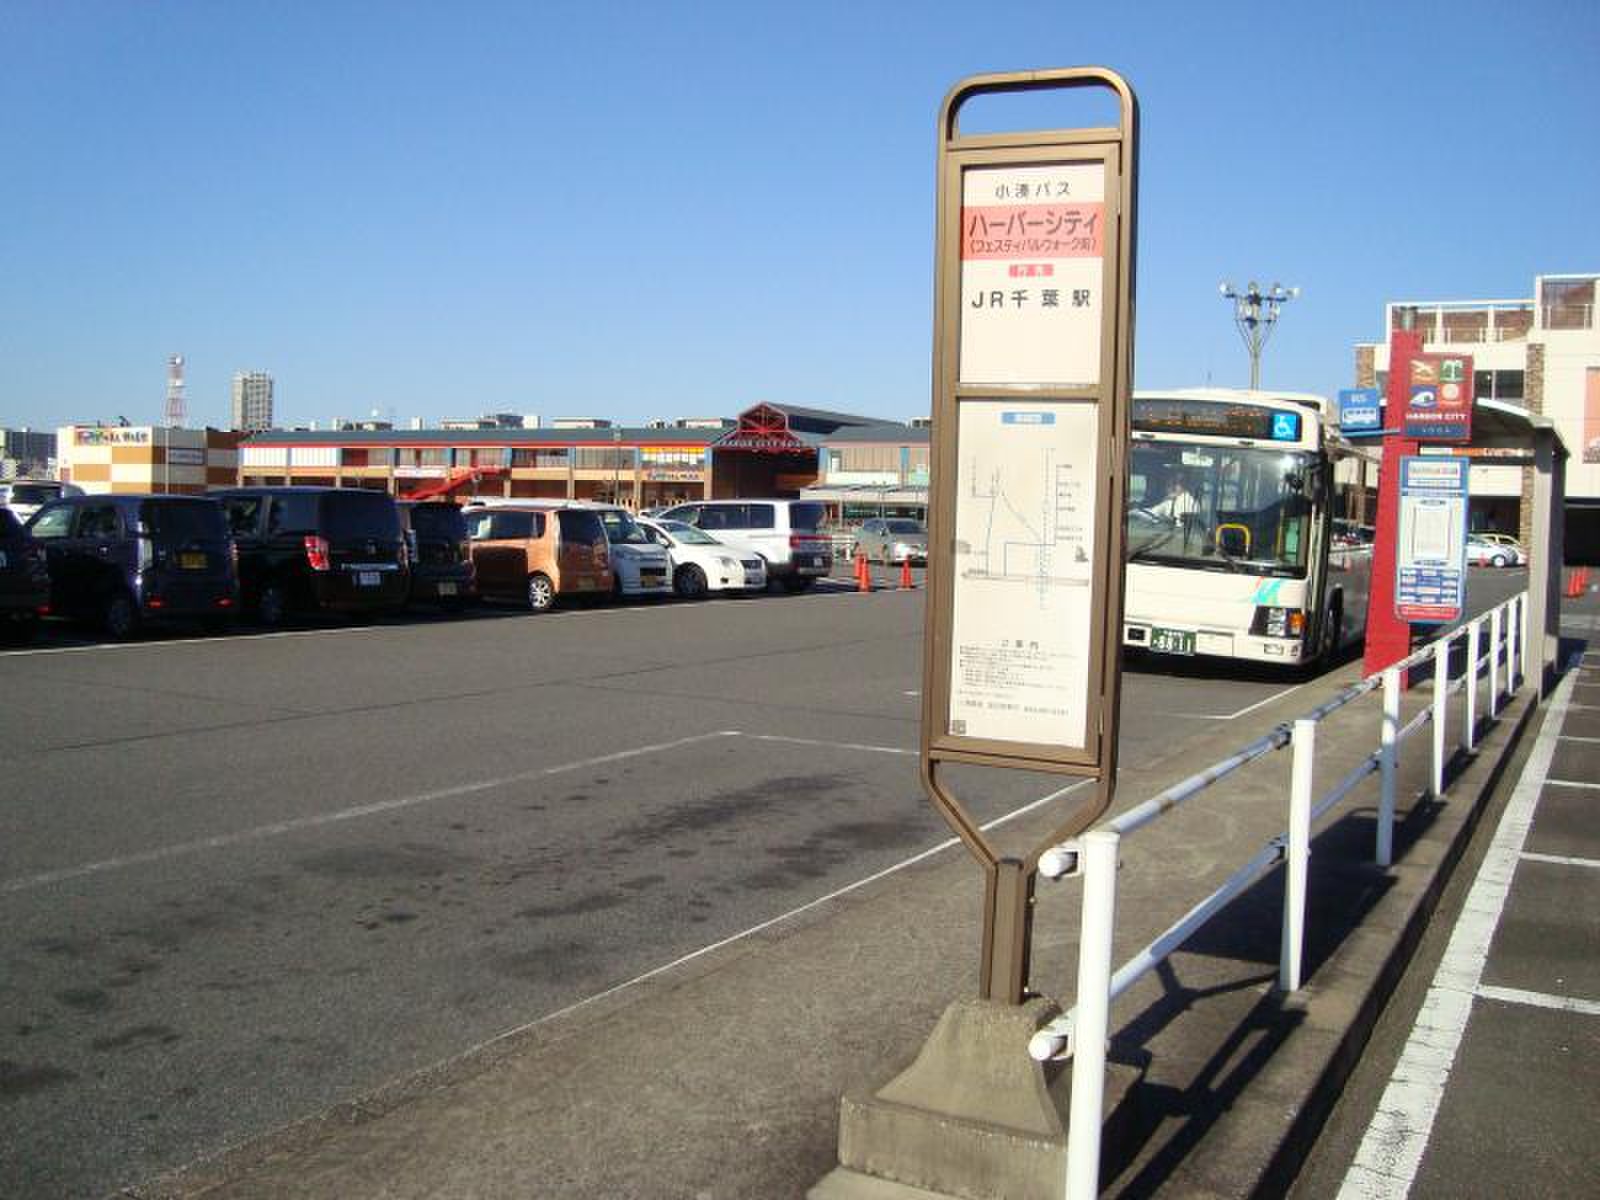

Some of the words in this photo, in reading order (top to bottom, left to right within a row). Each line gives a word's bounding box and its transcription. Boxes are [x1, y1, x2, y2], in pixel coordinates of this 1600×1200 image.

[969, 210, 1097, 237] ハーバーシティ
